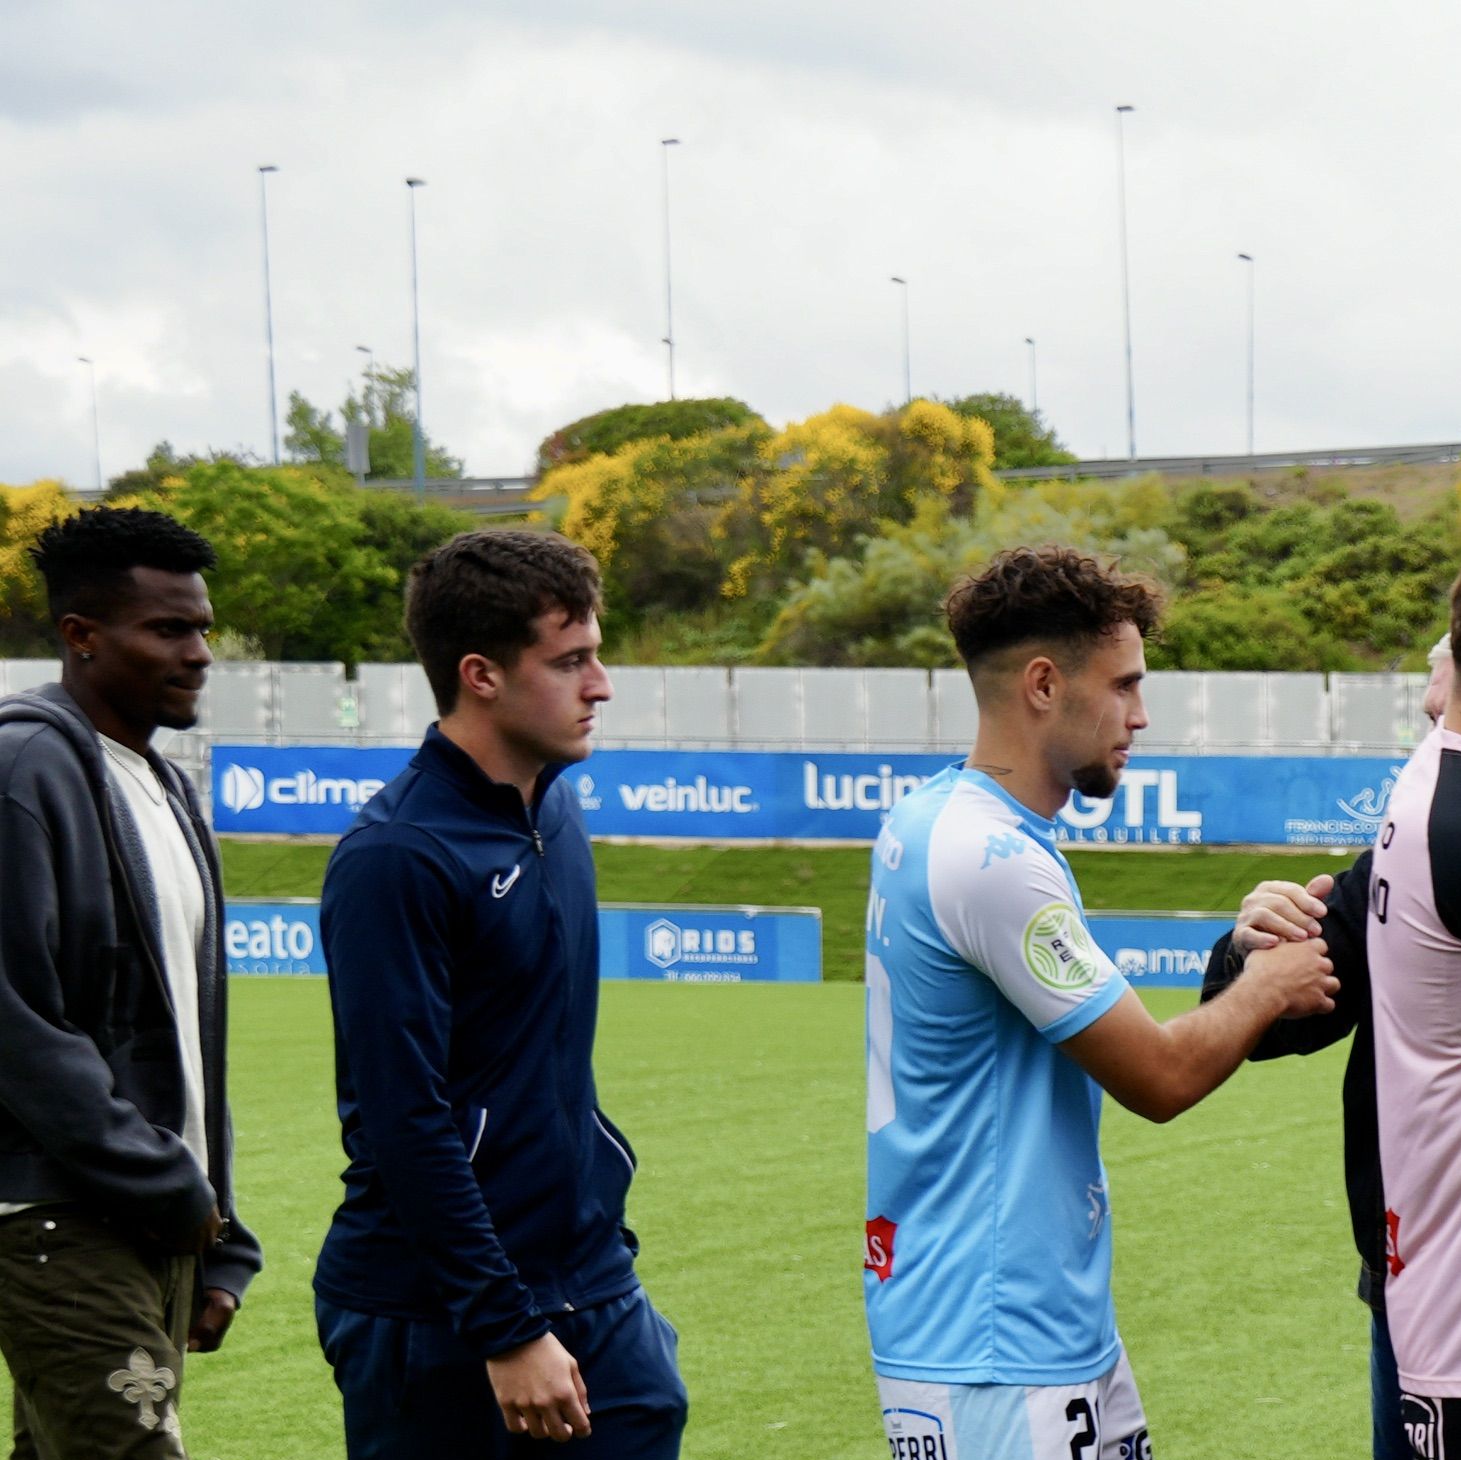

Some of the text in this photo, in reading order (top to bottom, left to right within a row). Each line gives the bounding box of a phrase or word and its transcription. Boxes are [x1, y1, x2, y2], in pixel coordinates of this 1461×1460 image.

[618, 775, 752, 813] veinluc
[1056, 827, 1202, 845] ALQUILER
[682, 928, 755, 954] RIOS
[1148, 948, 1212, 975] INTA
